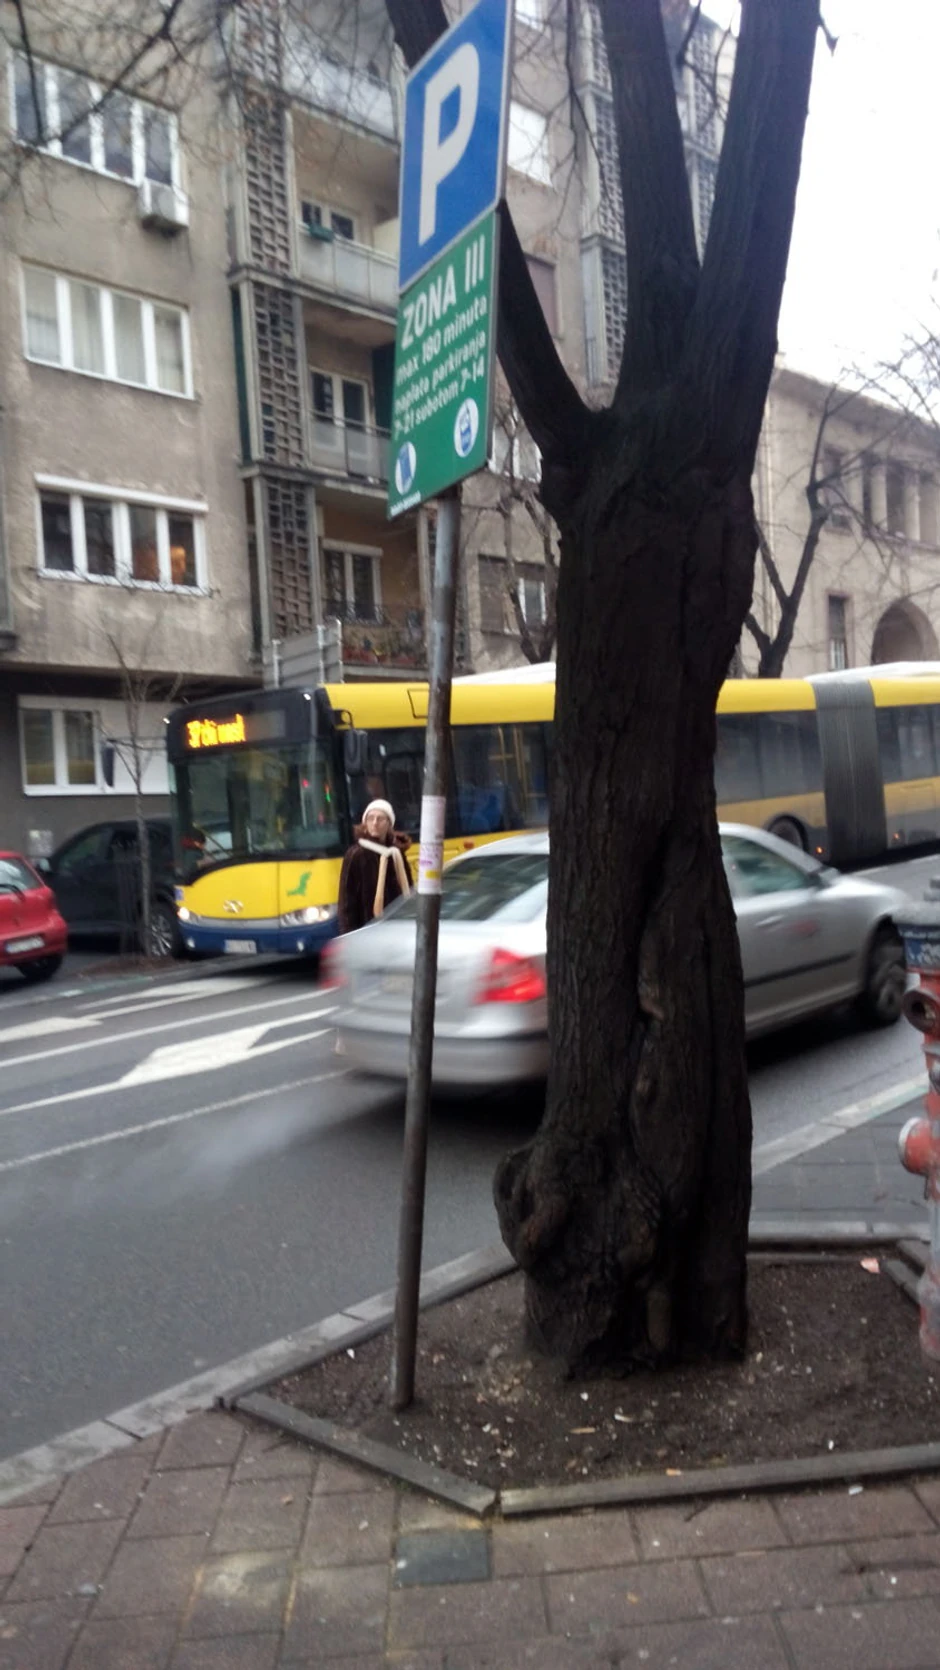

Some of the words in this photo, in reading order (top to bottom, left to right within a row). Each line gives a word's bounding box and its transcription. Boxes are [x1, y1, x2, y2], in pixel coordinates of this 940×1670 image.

[418, 42, 480, 246] P
[401, 264, 457, 351] ZONA
[465, 234, 485, 293] III
[395, 355, 419, 386] max
[421, 329, 442, 365] 180
[443, 295, 487, 347] minuta
[431, 330, 486, 391] parkiranja
[415, 380, 459, 426] subotom
[461, 354, 485, 392] 7-14
